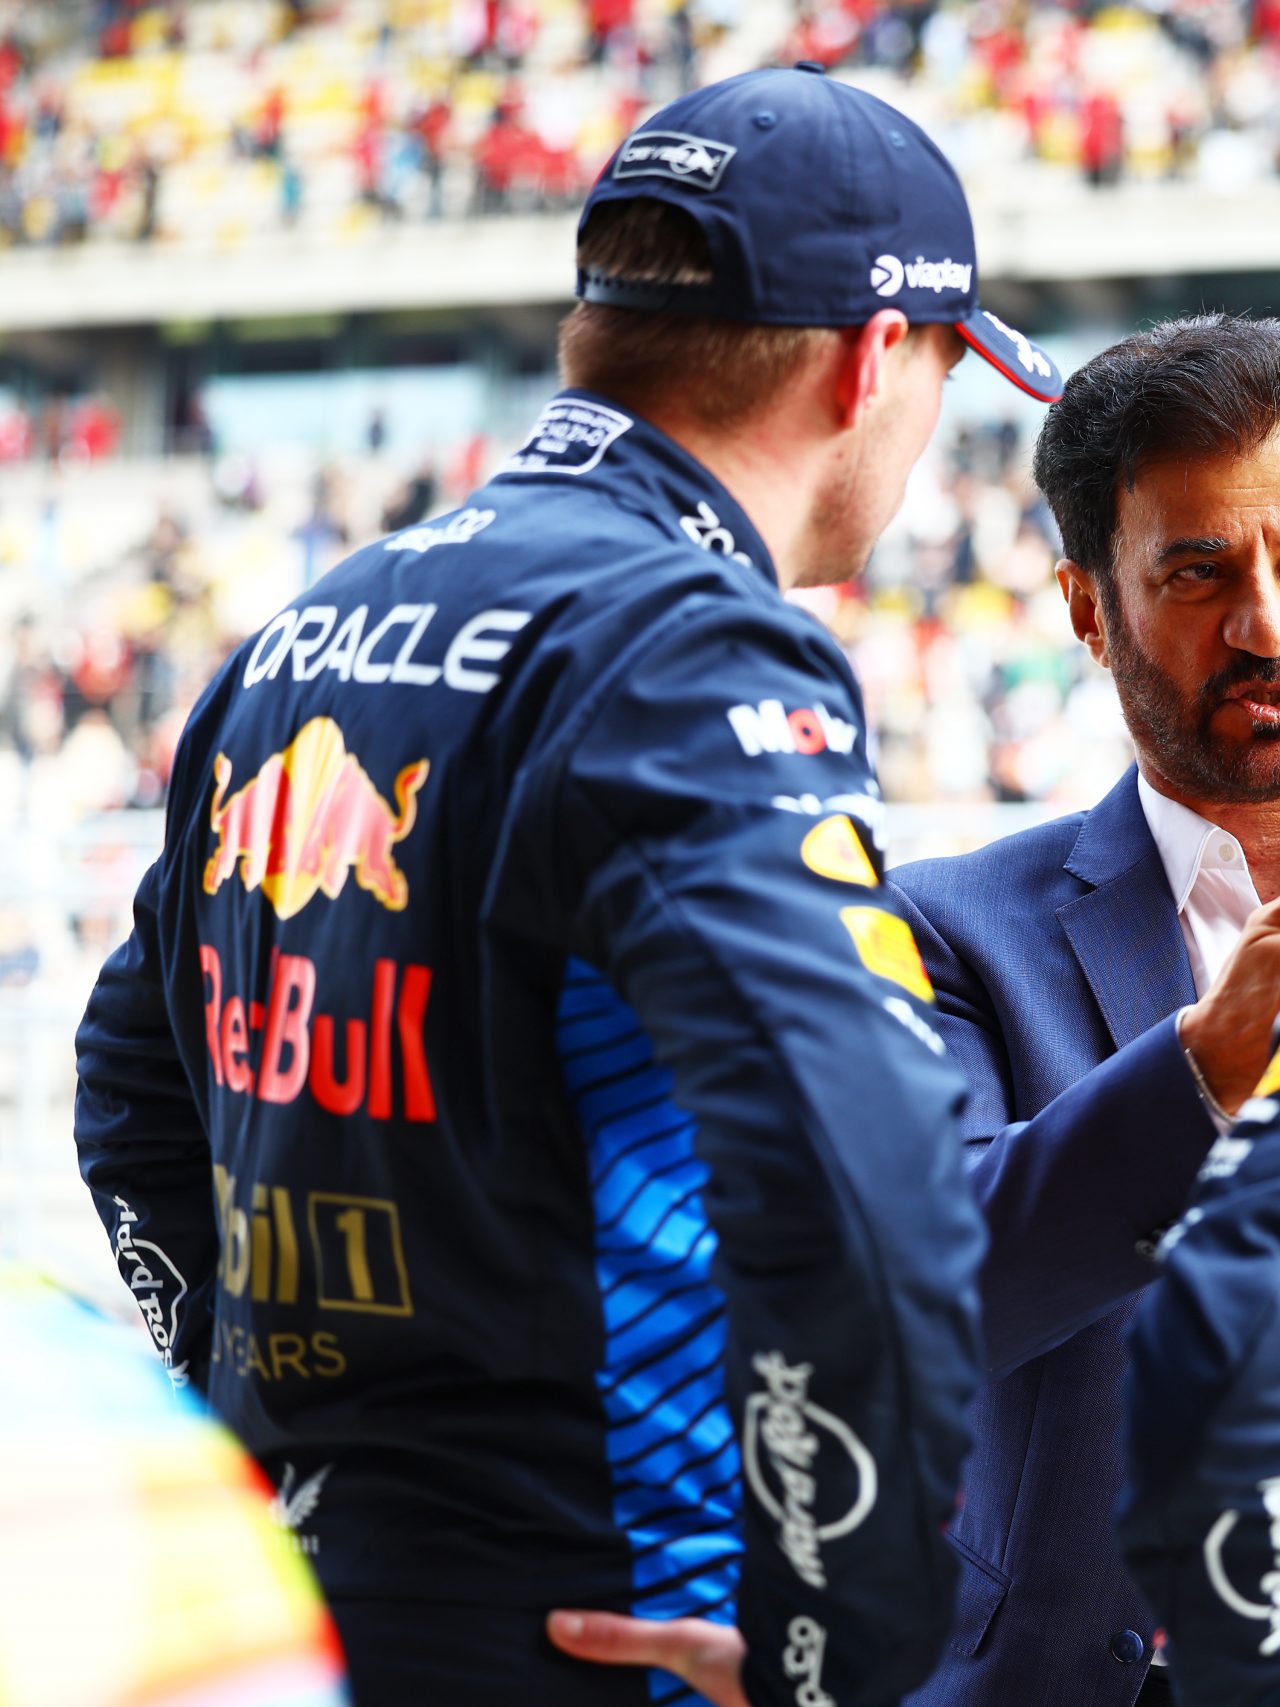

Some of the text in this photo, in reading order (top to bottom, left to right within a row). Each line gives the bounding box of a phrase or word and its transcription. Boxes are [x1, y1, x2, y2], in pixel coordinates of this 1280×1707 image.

[243, 604, 533, 693] ORACLE
[256, 953, 437, 1123] Bull
[336, 1209, 374, 1301] 1
